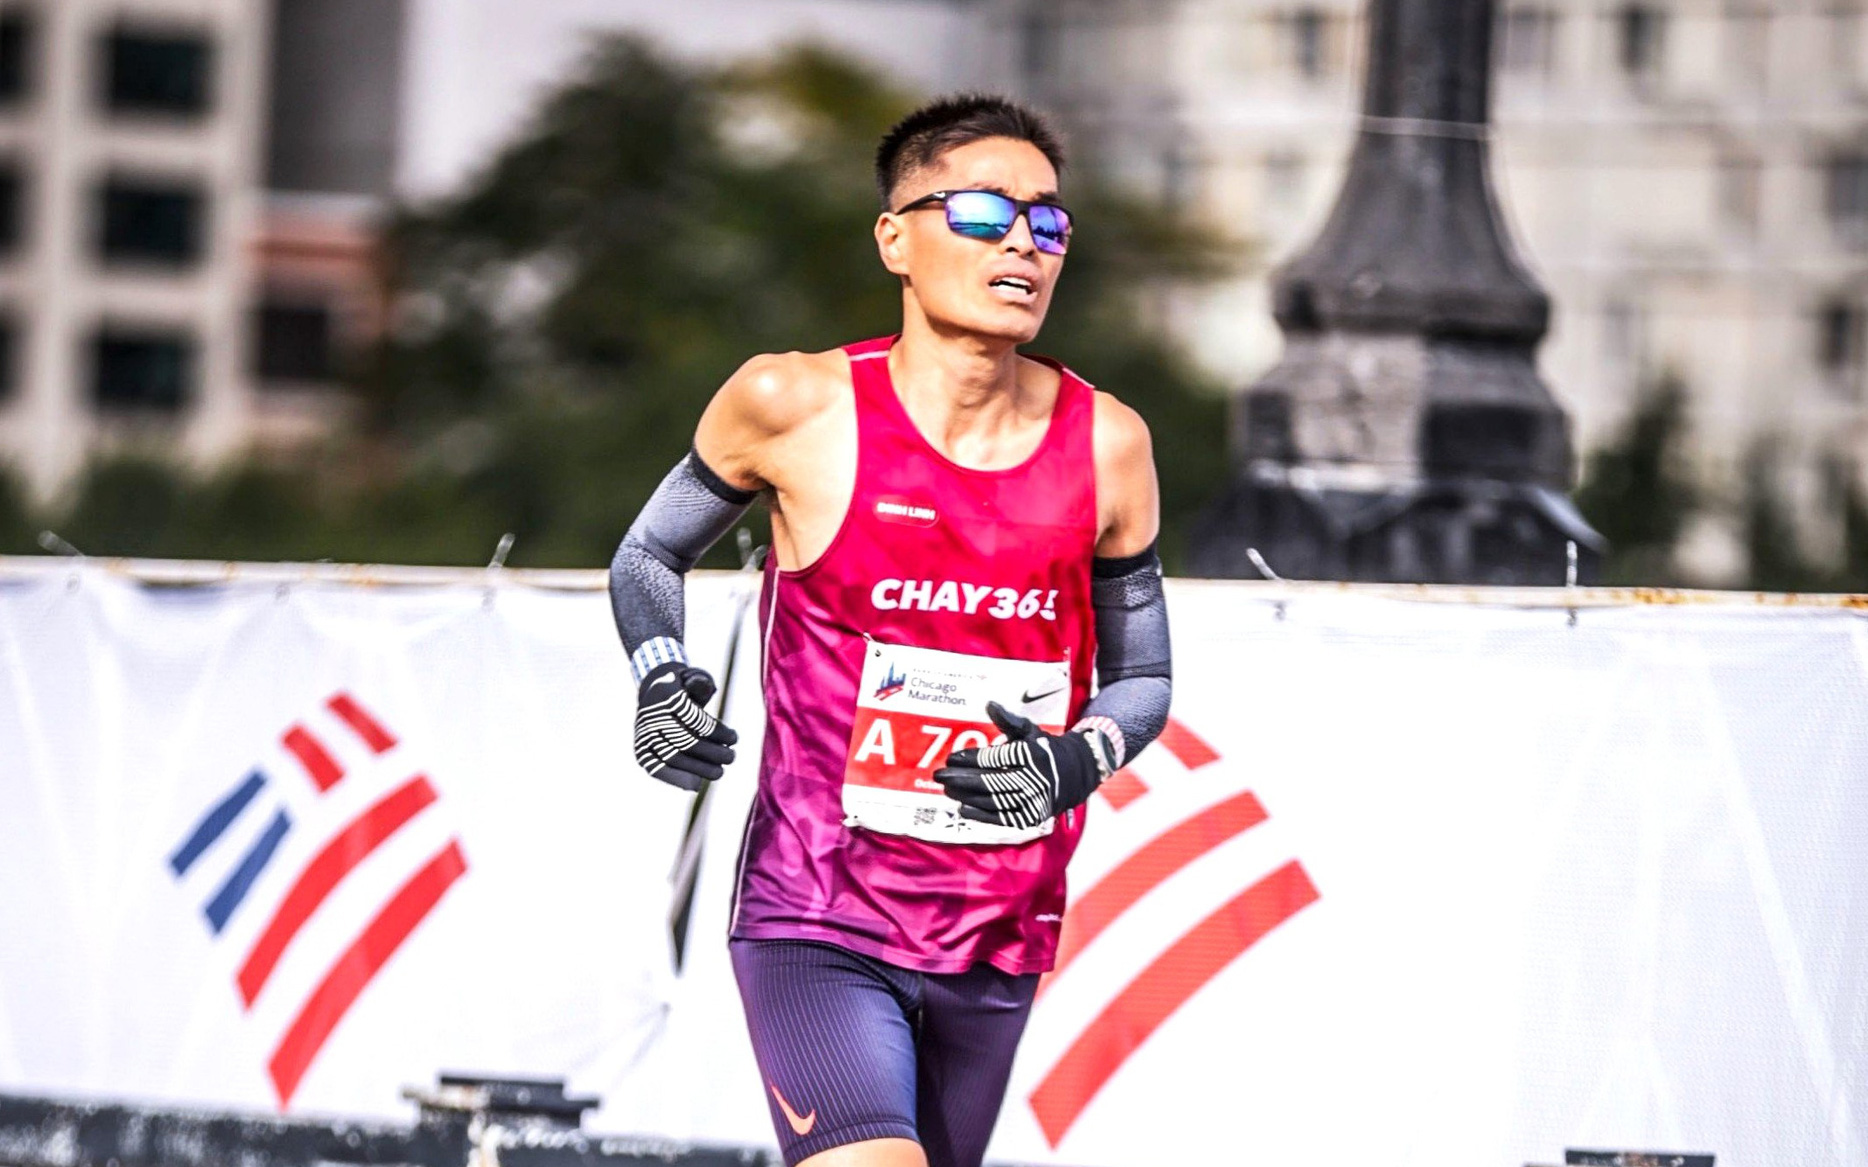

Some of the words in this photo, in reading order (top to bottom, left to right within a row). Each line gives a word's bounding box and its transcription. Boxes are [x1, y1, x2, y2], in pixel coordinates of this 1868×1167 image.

[910, 677, 957, 694] Chicago
[908, 690, 966, 706] Marathon
[854, 718, 896, 765] A
